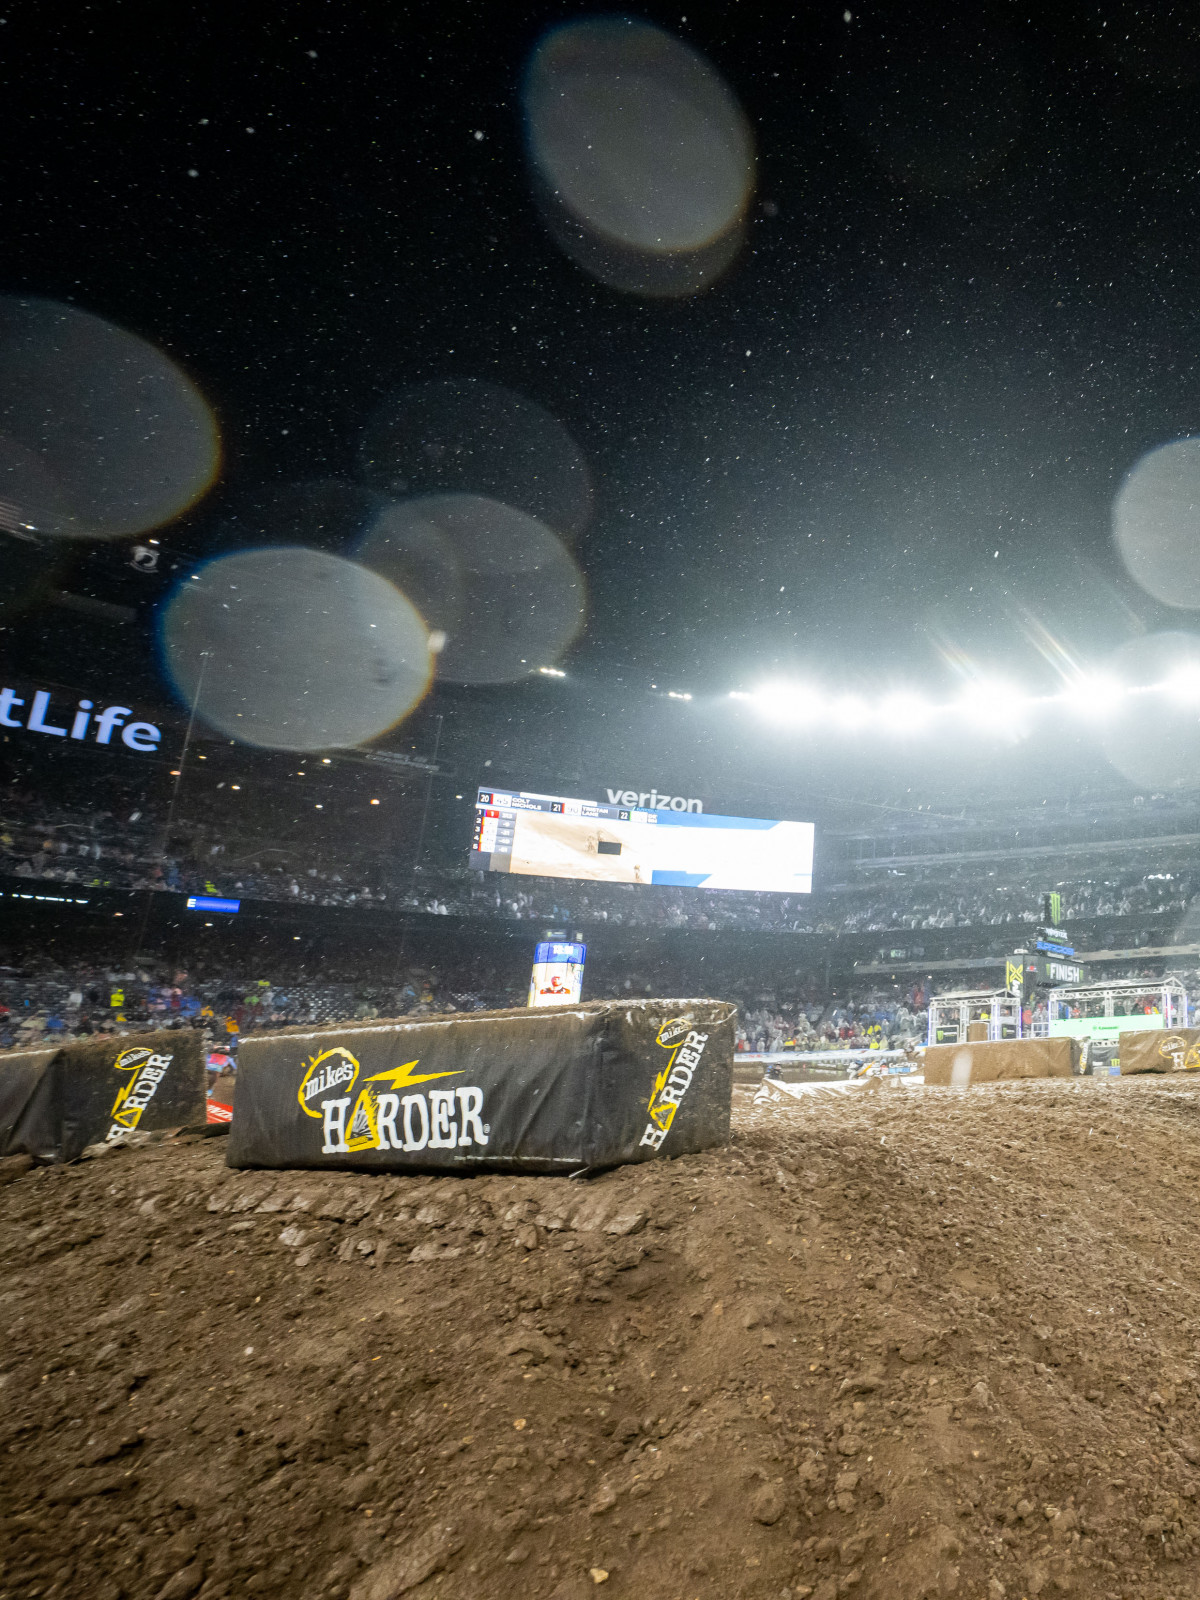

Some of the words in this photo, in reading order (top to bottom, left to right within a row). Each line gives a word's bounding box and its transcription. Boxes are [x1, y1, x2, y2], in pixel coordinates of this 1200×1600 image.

[480, 793, 490, 803] 20
[553, 804, 561, 812] 21
[606, 788, 703, 814] verizon
[620, 812, 629, 820] 22
[1050, 963, 1080, 983] FINISH
[304, 1060, 355, 1101] mike's
[639, 1031, 709, 1151] HARDER
[321, 1086, 489, 1154] HARDER
